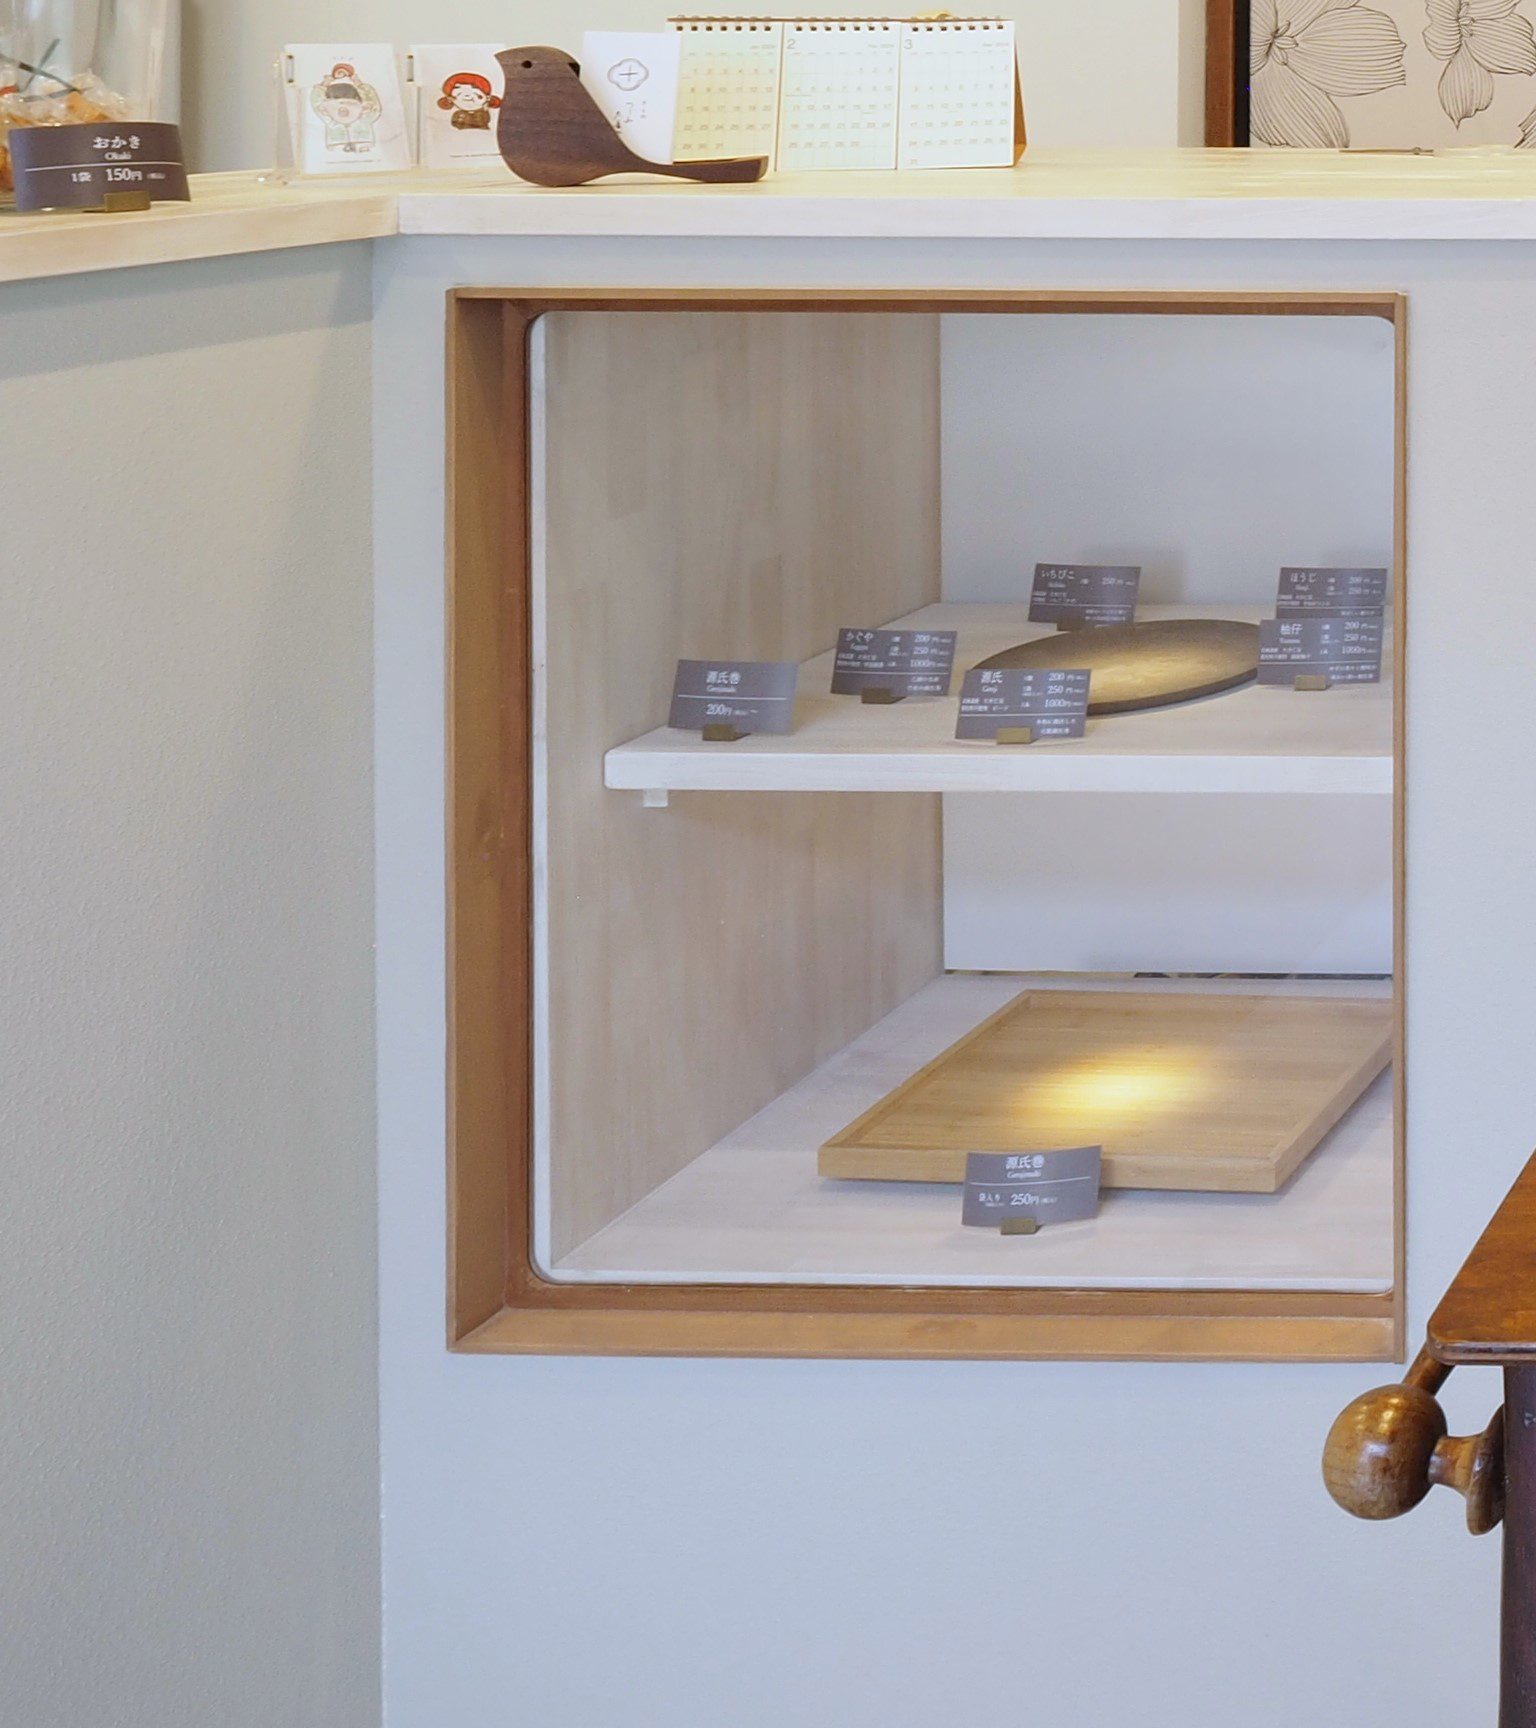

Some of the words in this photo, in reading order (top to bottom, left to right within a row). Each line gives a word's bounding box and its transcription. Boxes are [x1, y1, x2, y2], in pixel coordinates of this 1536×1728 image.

[786, 38, 796, 50] 2
[904, 39, 913, 50] 3
[93, 135, 140, 149] おかき
[106, 168, 143, 182] 150円
